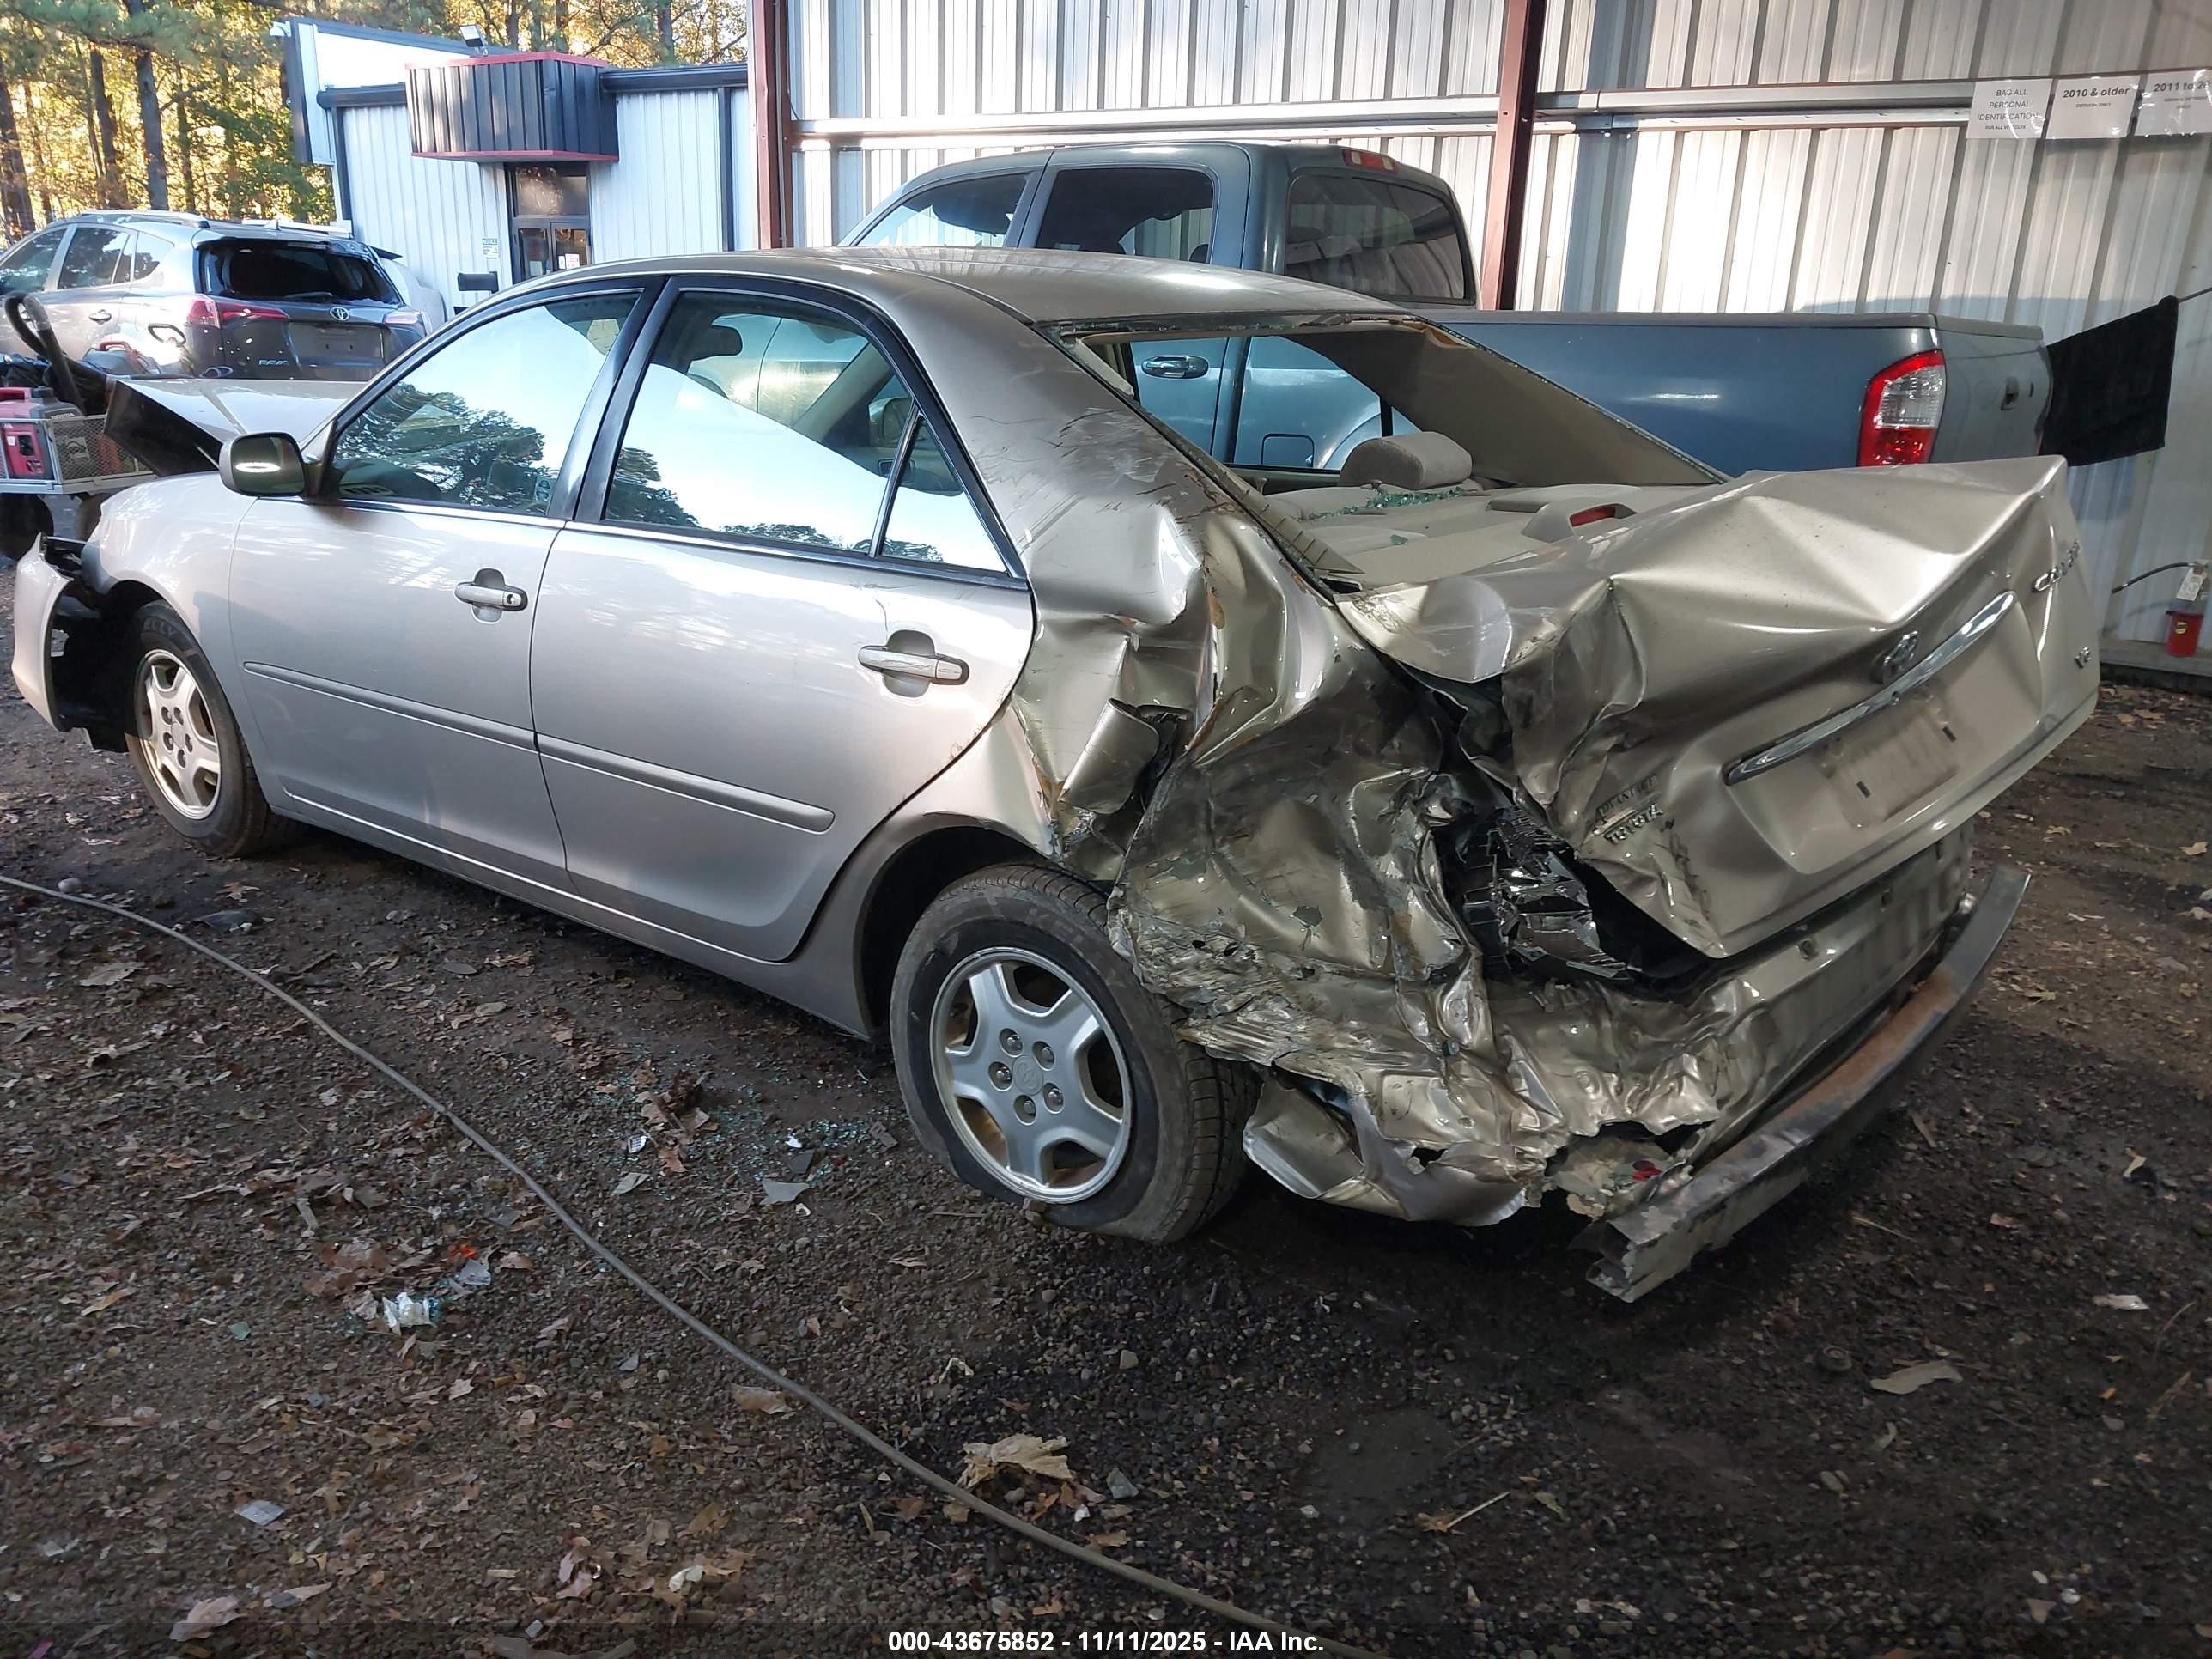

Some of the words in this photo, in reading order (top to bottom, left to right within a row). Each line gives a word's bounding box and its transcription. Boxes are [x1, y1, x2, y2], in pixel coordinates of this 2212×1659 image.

[2154, 82, 2179, 92] 2011
[2063, 88, 2087, 98] 2010
[2090, 88, 2098, 97] &
[2100, 87, 2130, 96] older
